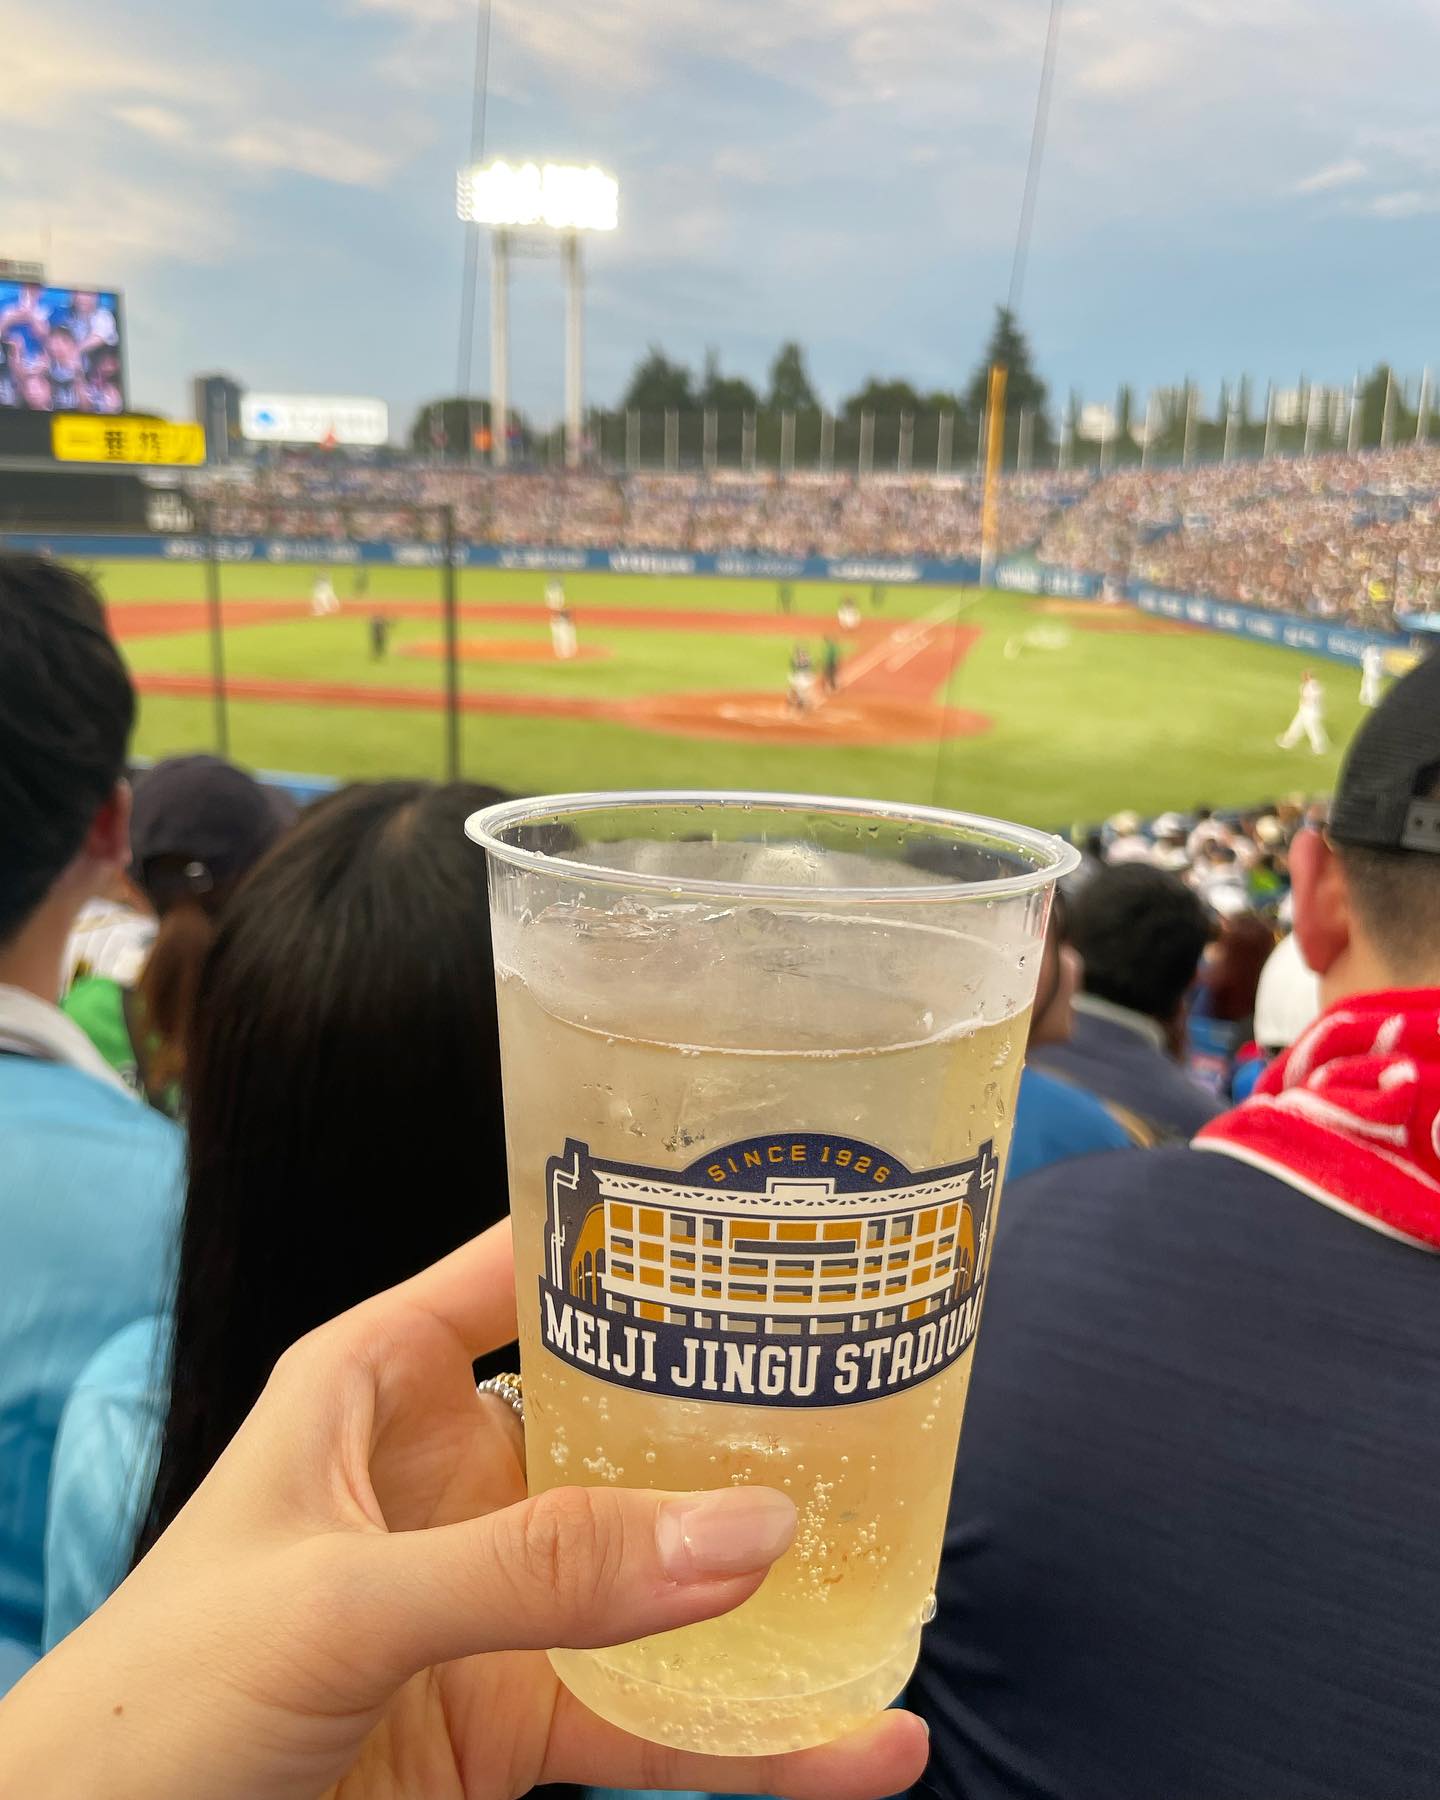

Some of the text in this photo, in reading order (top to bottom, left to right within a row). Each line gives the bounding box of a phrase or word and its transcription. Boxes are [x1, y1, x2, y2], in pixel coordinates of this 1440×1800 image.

[707, 1144, 891, 1184] SINCE 1926
[544, 1284, 982, 1396] MEIJI JINGU STADIUM
